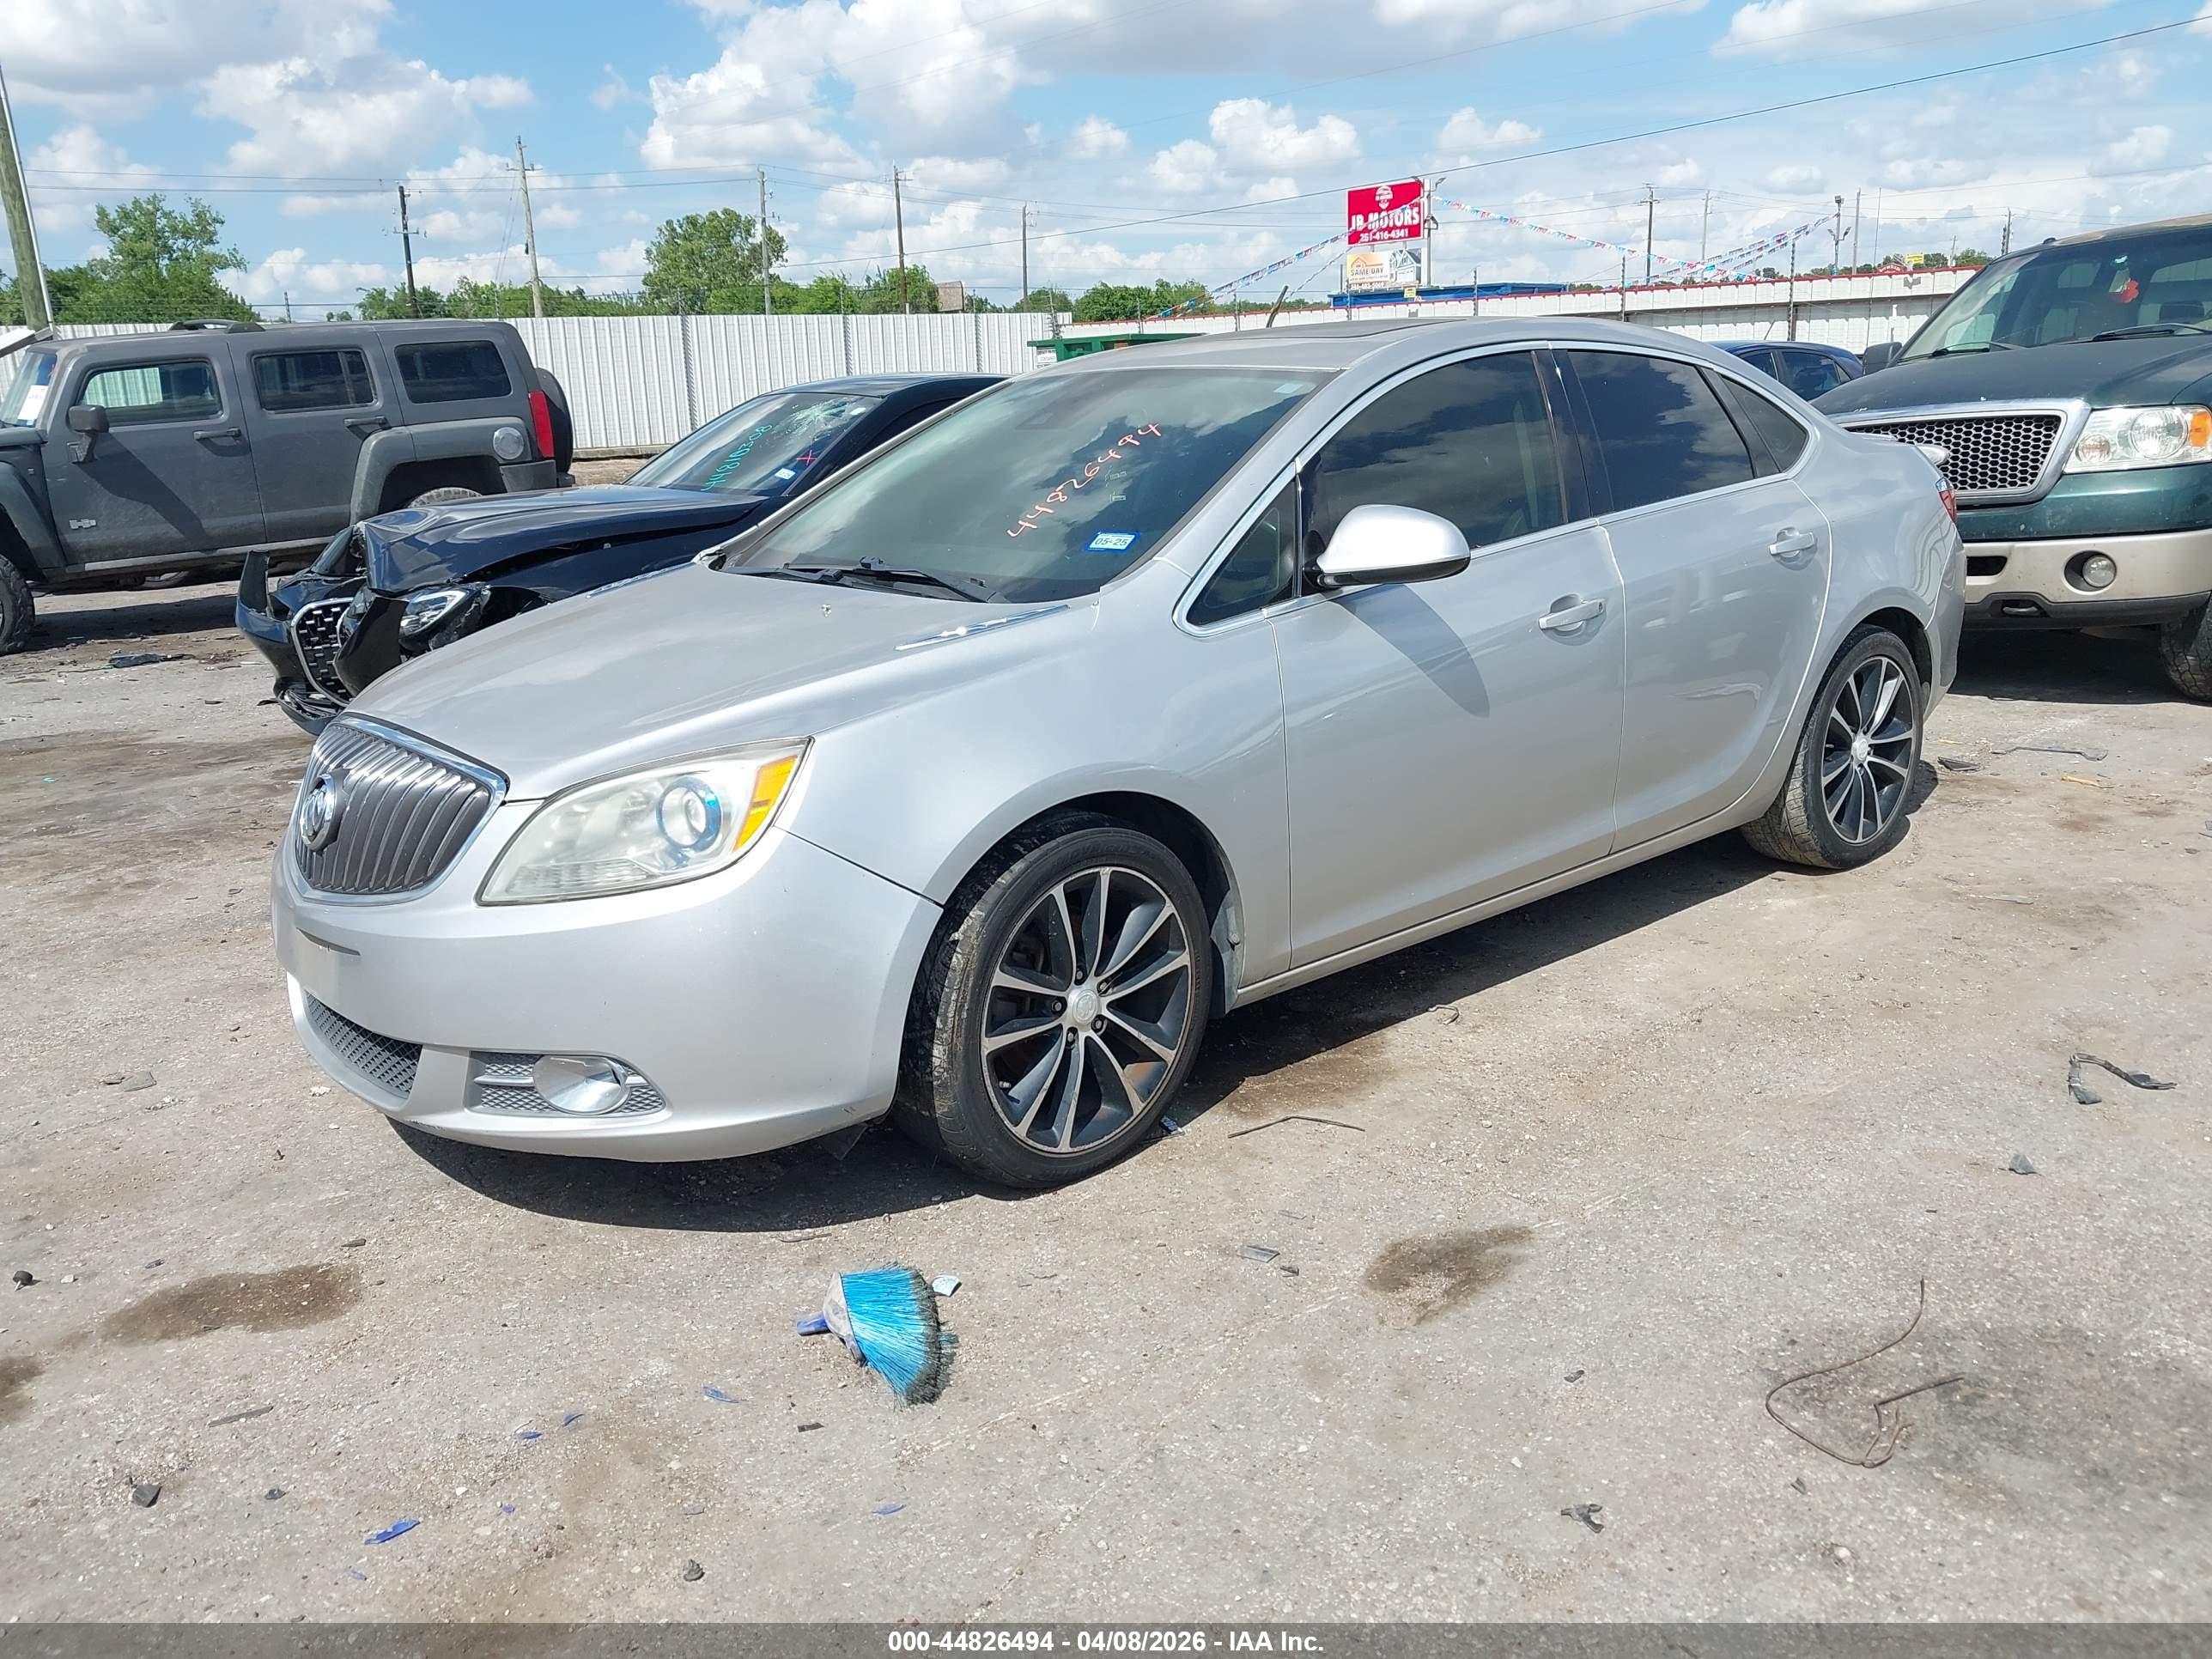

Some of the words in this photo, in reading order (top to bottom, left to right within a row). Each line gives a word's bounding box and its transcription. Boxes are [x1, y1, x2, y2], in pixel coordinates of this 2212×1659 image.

[1368, 207, 1419, 230] MOTORS
[1351, 267, 1369, 276] SAME
[1006, 422, 1162, 538] 44826494
